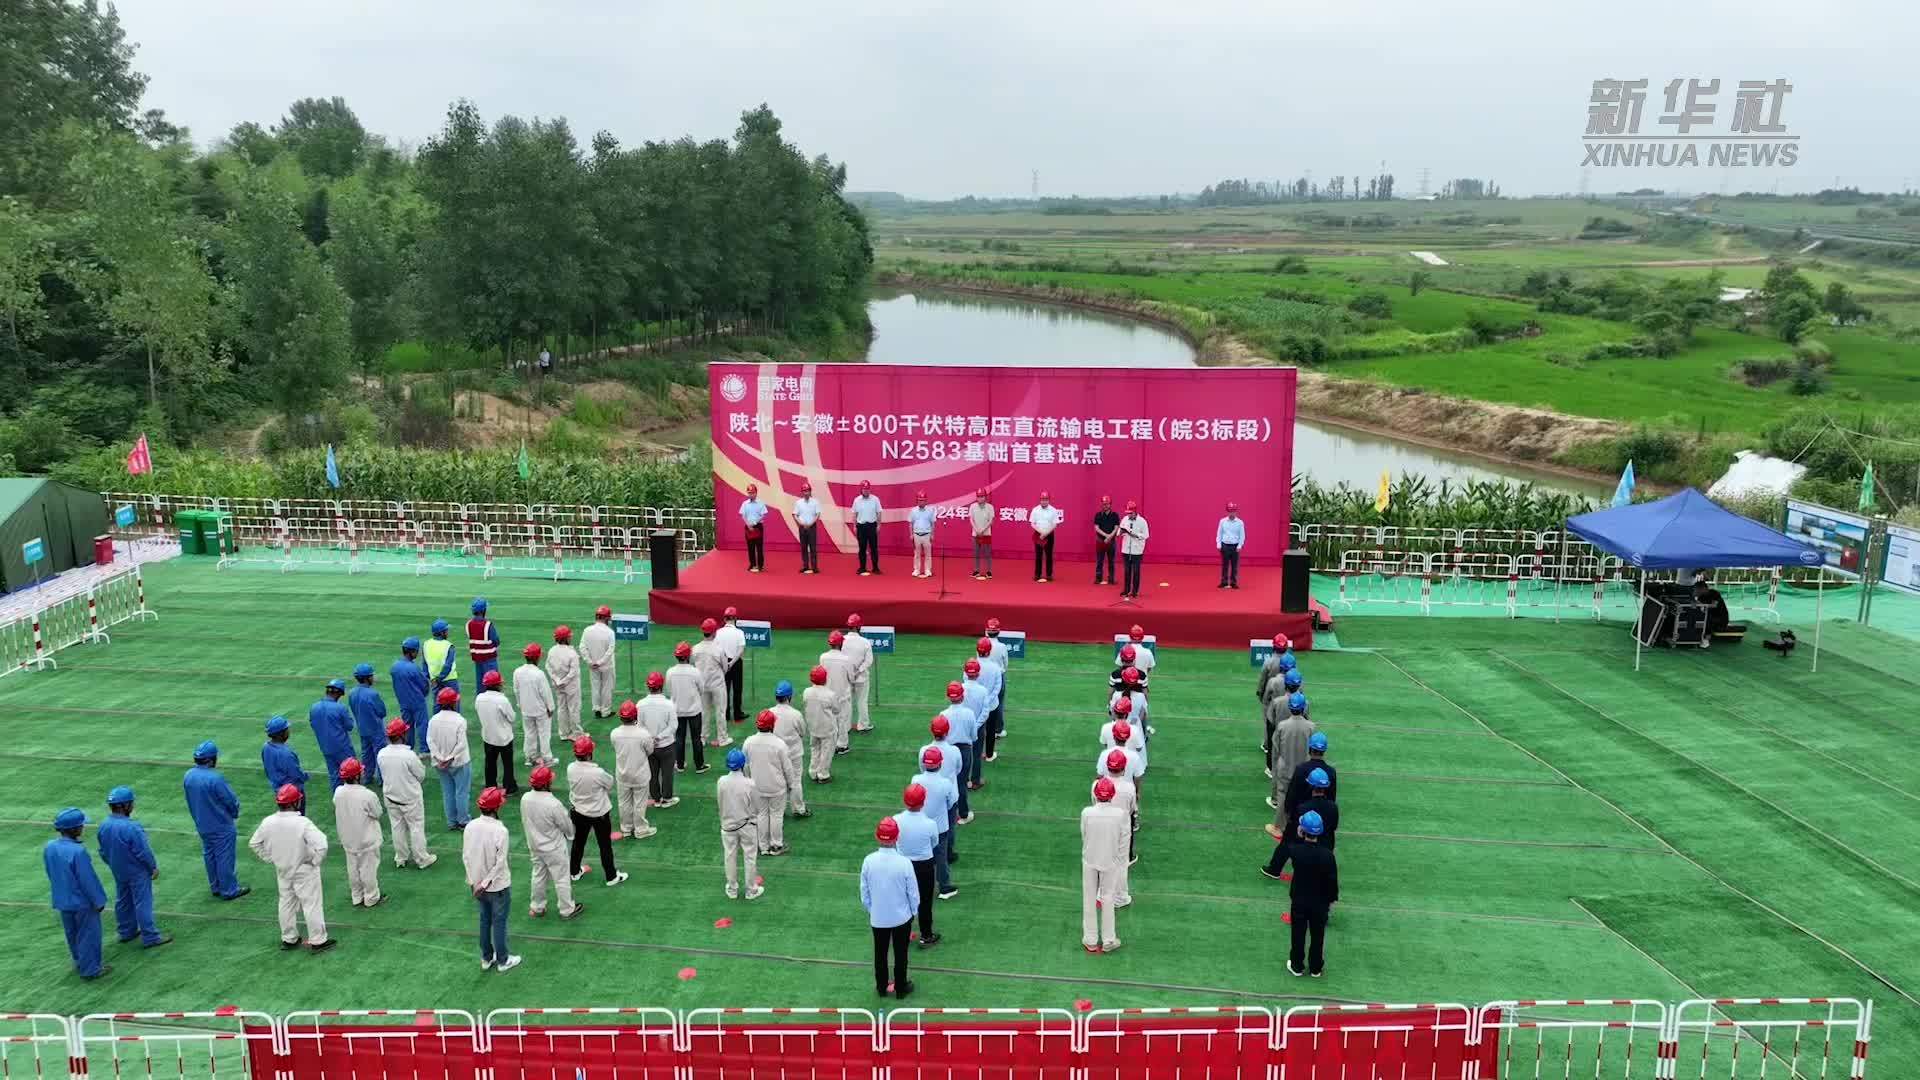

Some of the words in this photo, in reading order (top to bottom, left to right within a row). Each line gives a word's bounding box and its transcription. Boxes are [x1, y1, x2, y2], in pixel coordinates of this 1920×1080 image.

[758, 376, 813, 392] 国家电网
[882, 439, 1103, 465] N2583基础首基试点
